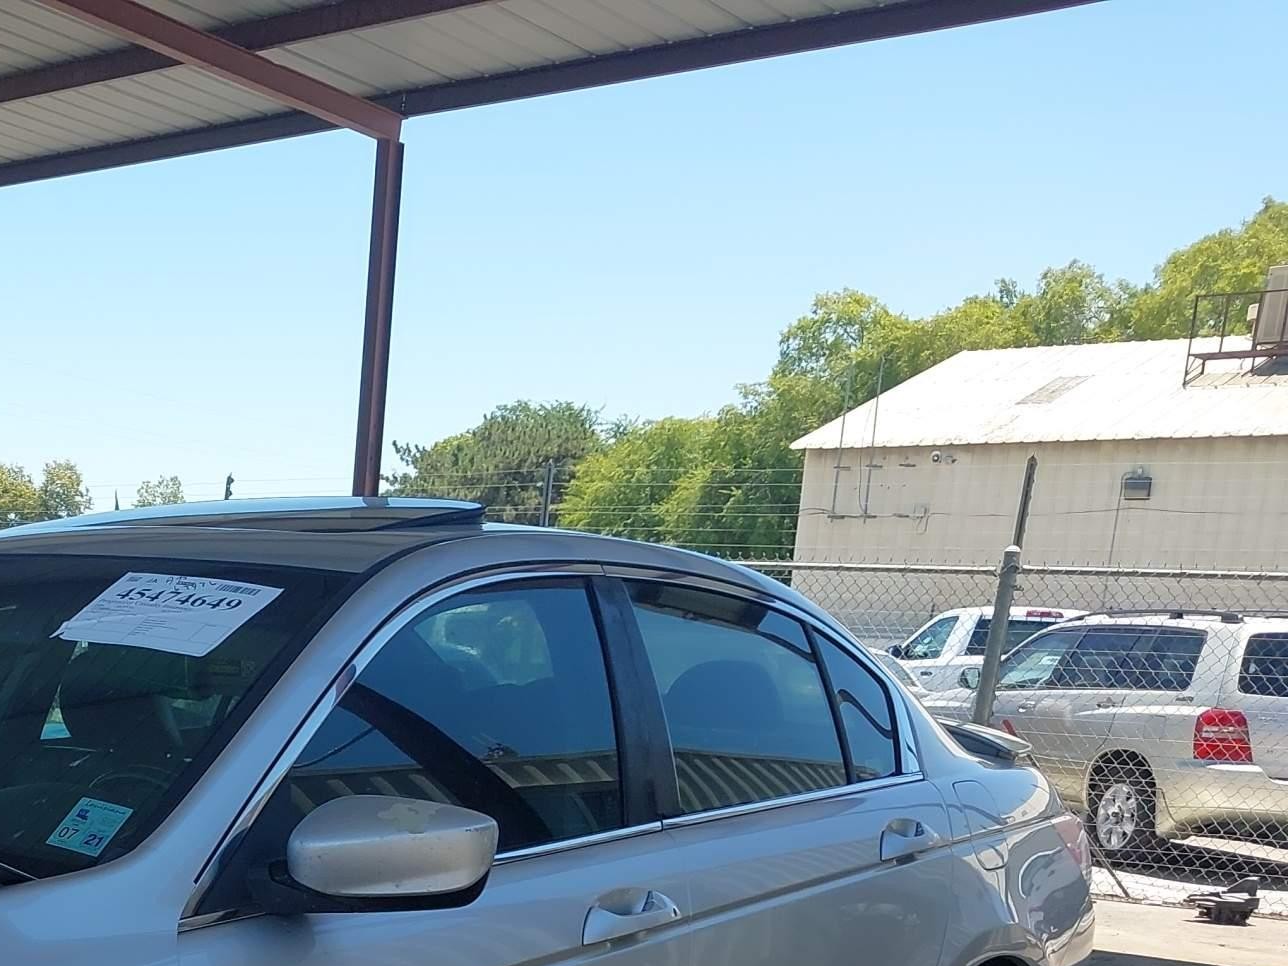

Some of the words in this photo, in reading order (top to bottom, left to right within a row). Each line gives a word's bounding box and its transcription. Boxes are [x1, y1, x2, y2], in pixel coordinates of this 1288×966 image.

[116, 587, 242, 610] 45474649
[58, 826, 80, 840] 07
[83, 833, 105, 847] 21
